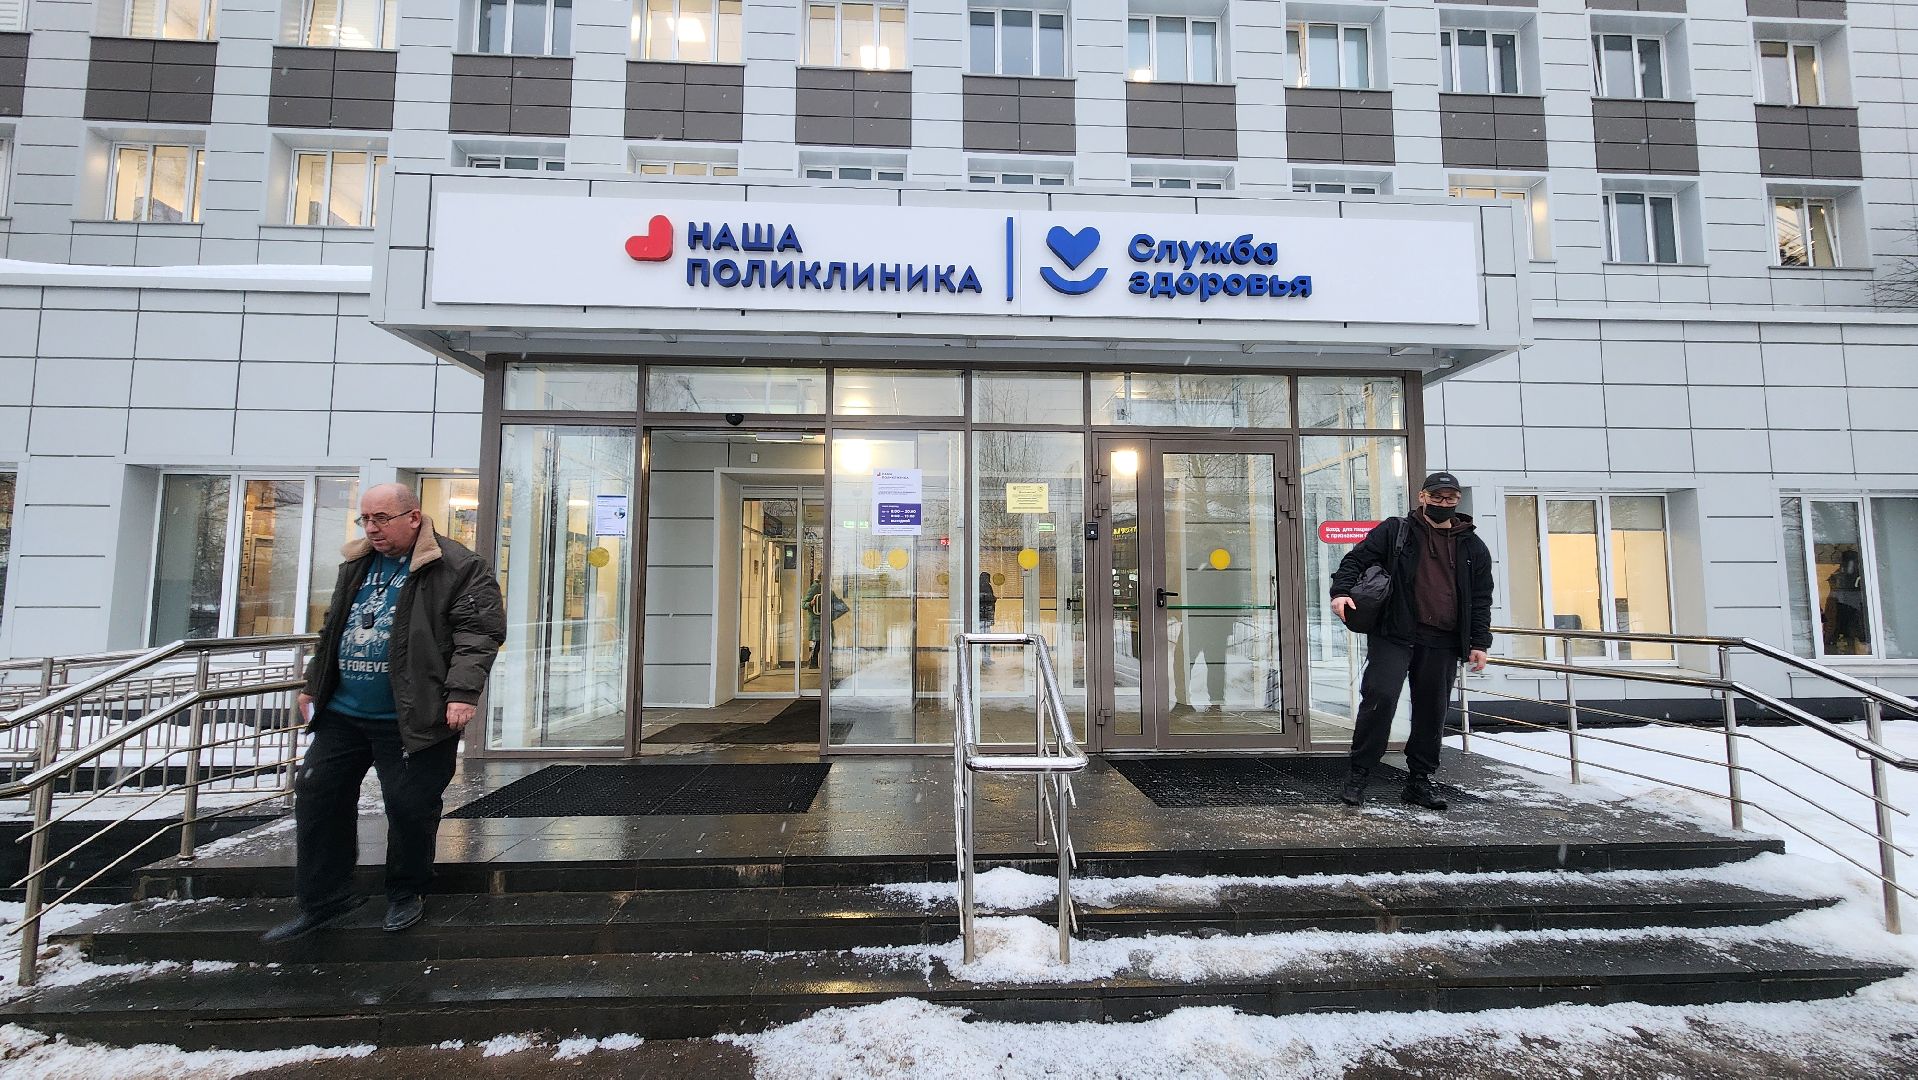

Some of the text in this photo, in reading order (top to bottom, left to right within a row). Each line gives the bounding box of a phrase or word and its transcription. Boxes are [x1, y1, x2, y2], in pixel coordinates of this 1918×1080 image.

[687, 221, 803, 253] НАША
[1128, 233, 1278, 270] Служба
[686, 257, 983, 294] ПОЛИКЛИНИКА
[1128, 271, 1312, 302] здоровья
[347, 660, 389, 673] FOREVE
